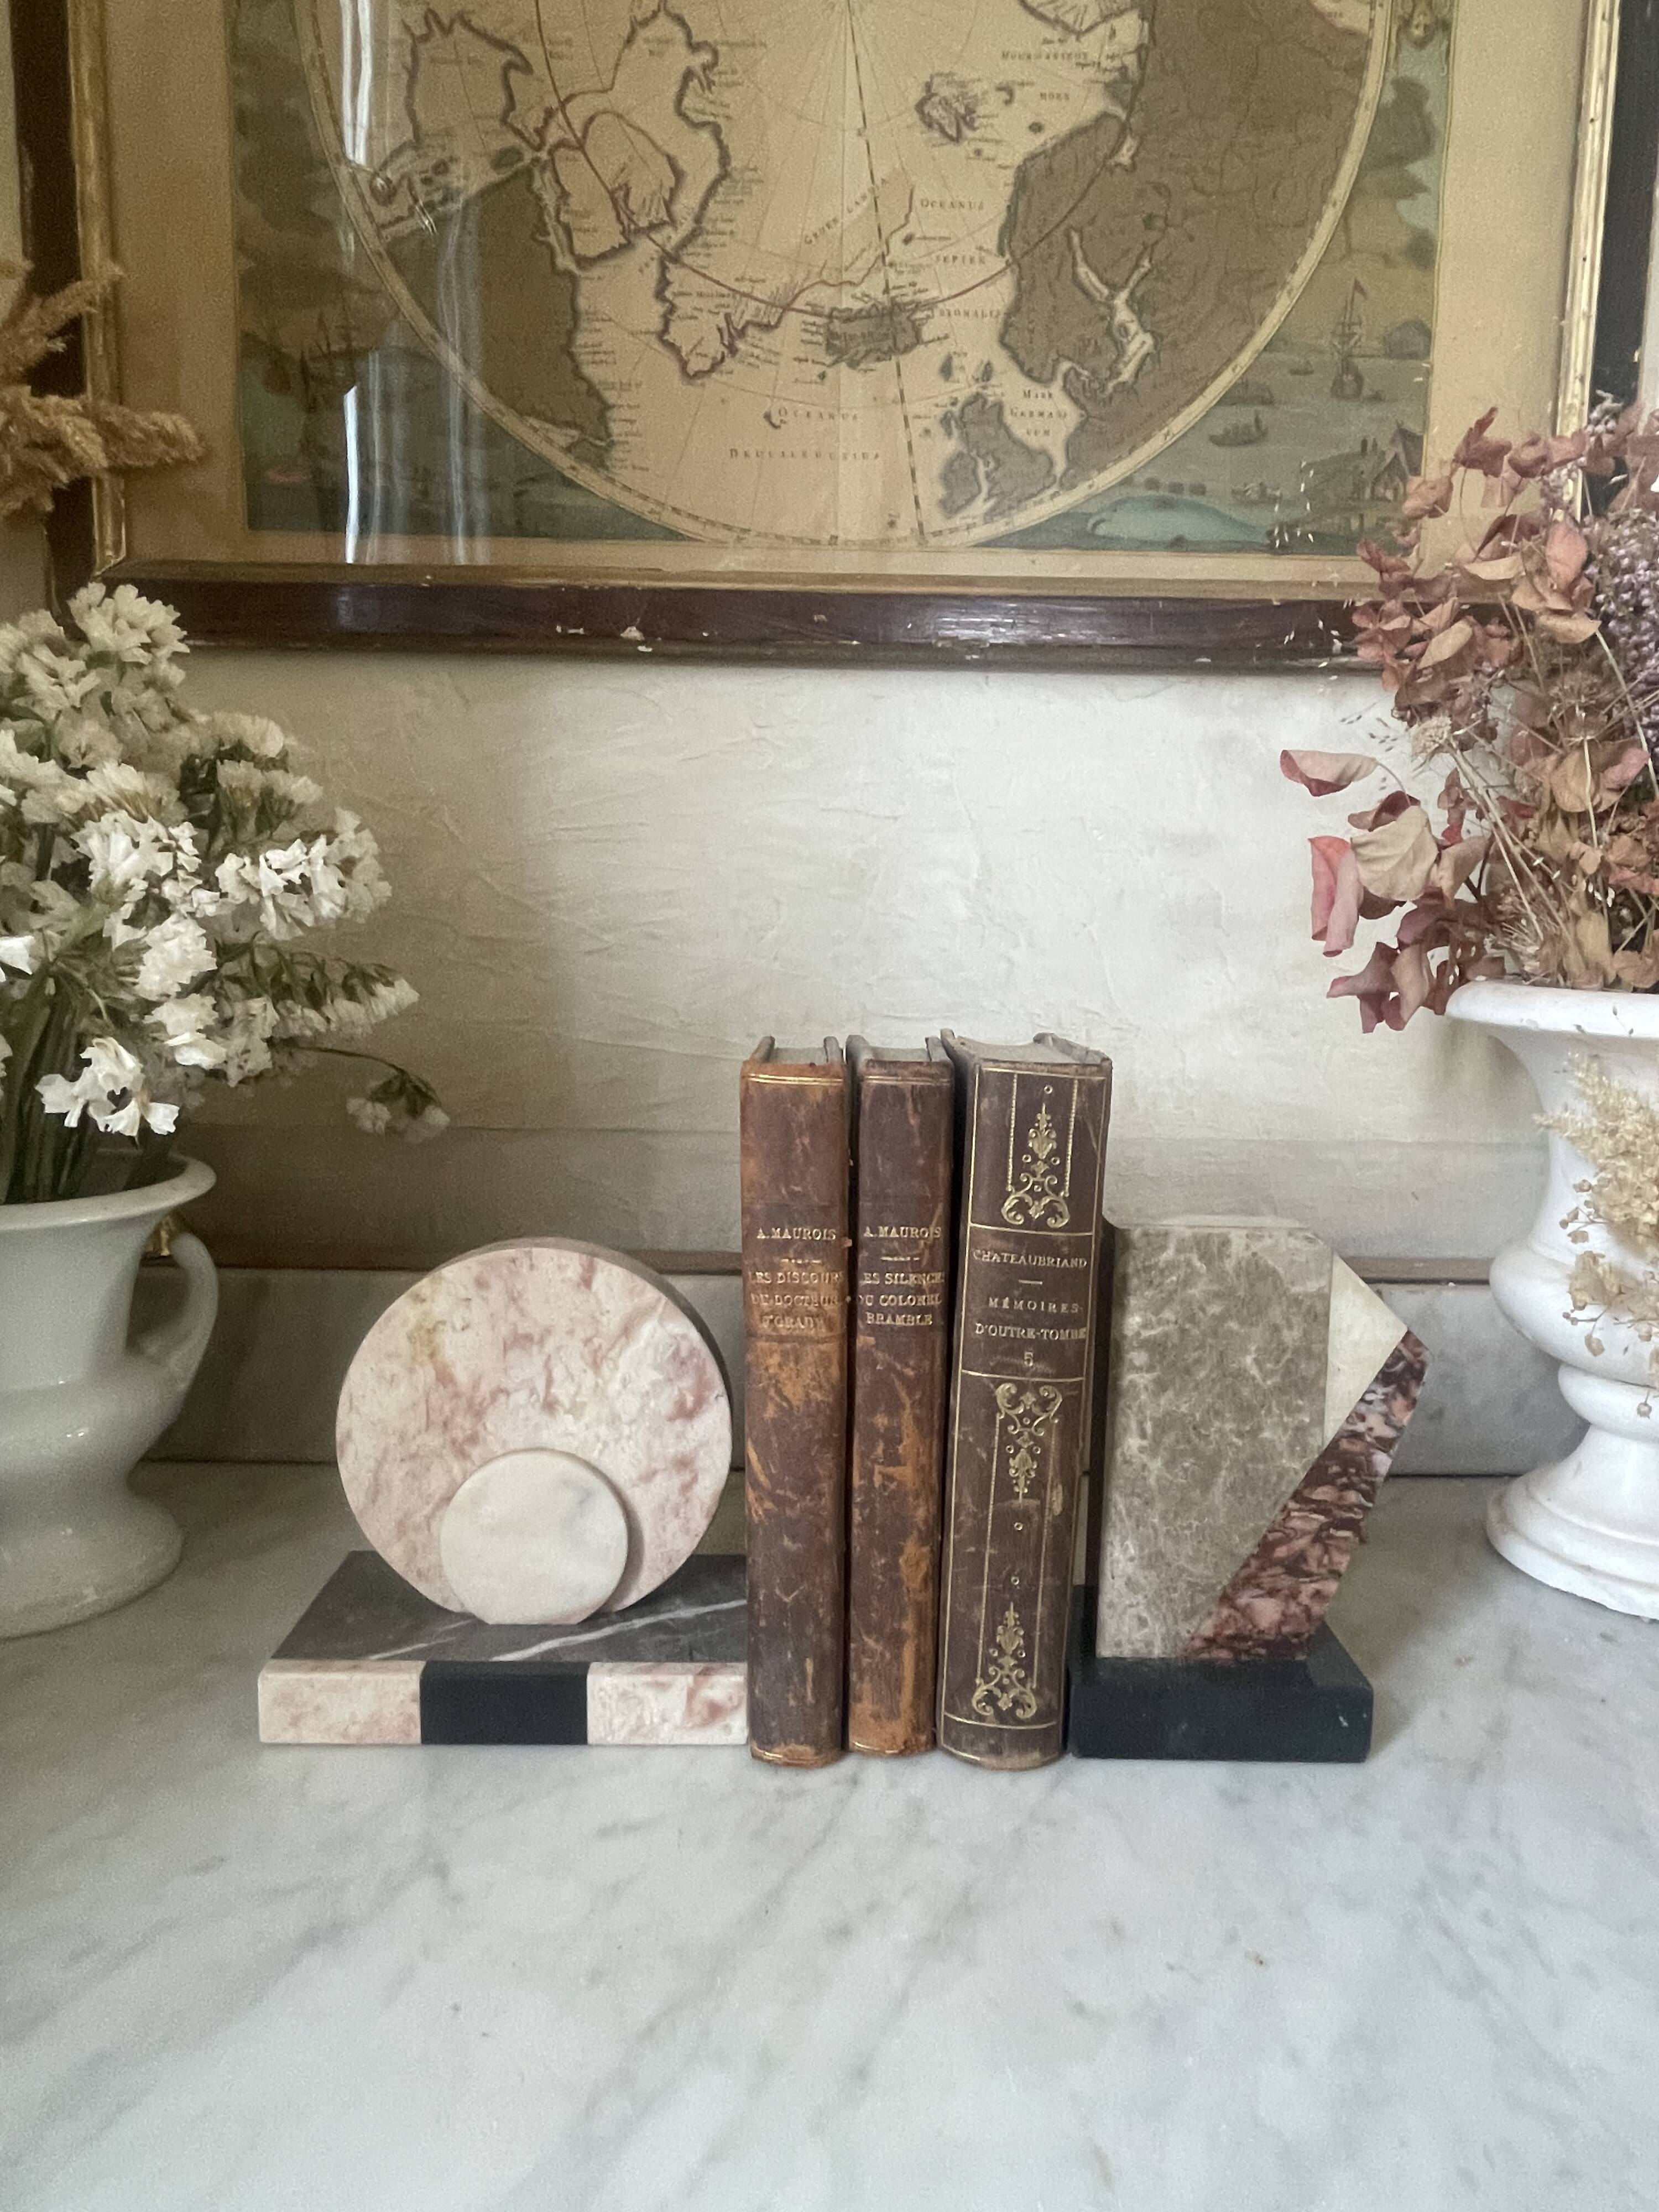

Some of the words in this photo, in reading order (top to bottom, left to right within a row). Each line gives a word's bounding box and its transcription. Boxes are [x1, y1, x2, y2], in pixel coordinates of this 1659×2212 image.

[973, 1249, 1087, 1268] CHATEAUBRIAND
[865, 1312, 933, 1326] BRAMBLE
[1024, 1352, 1034, 1367] 5
